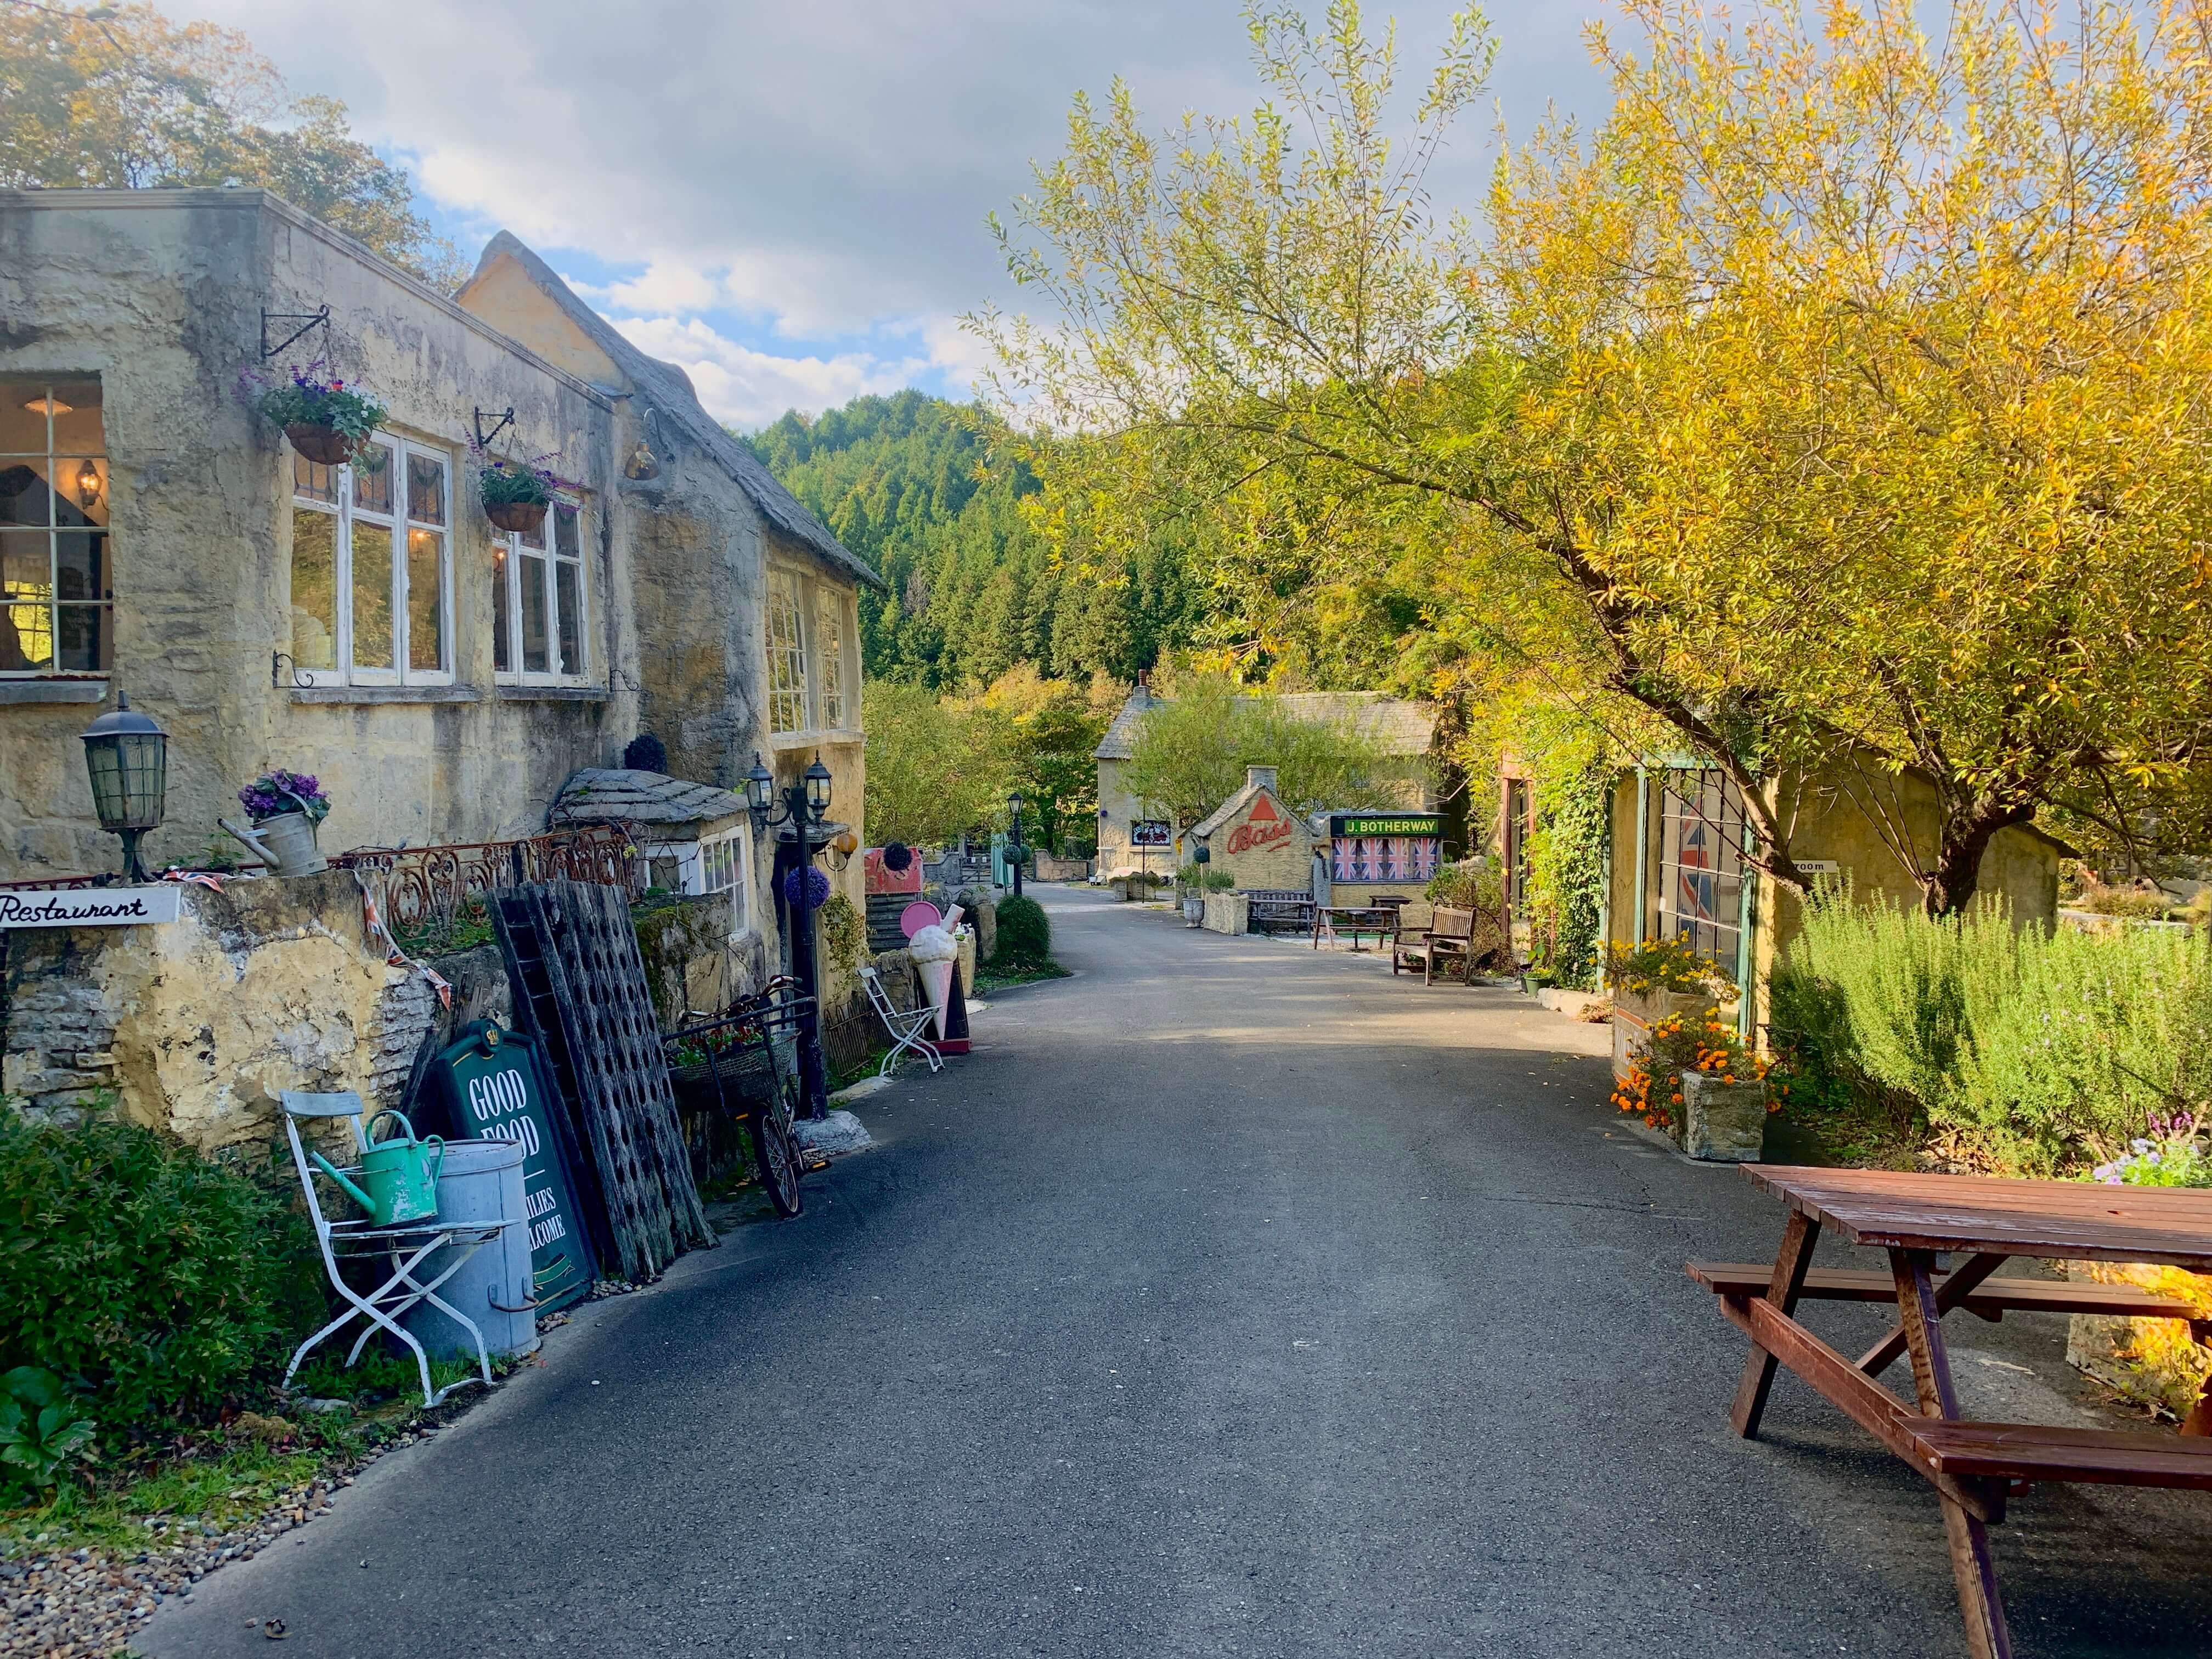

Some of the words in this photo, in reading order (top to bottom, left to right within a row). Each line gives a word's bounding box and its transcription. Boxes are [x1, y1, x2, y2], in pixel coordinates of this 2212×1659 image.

[1228, 817, 1291, 854] Bass
[1347, 822, 1358, 832] J.
[1360, 821, 1435, 832] BOTHERWAY
[0, 895, 148, 922] Restaurant
[469, 1069, 527, 1121] GOOD
[526, 1187, 556, 1220] ILIES
[529, 1214, 566, 1251] LCOME
